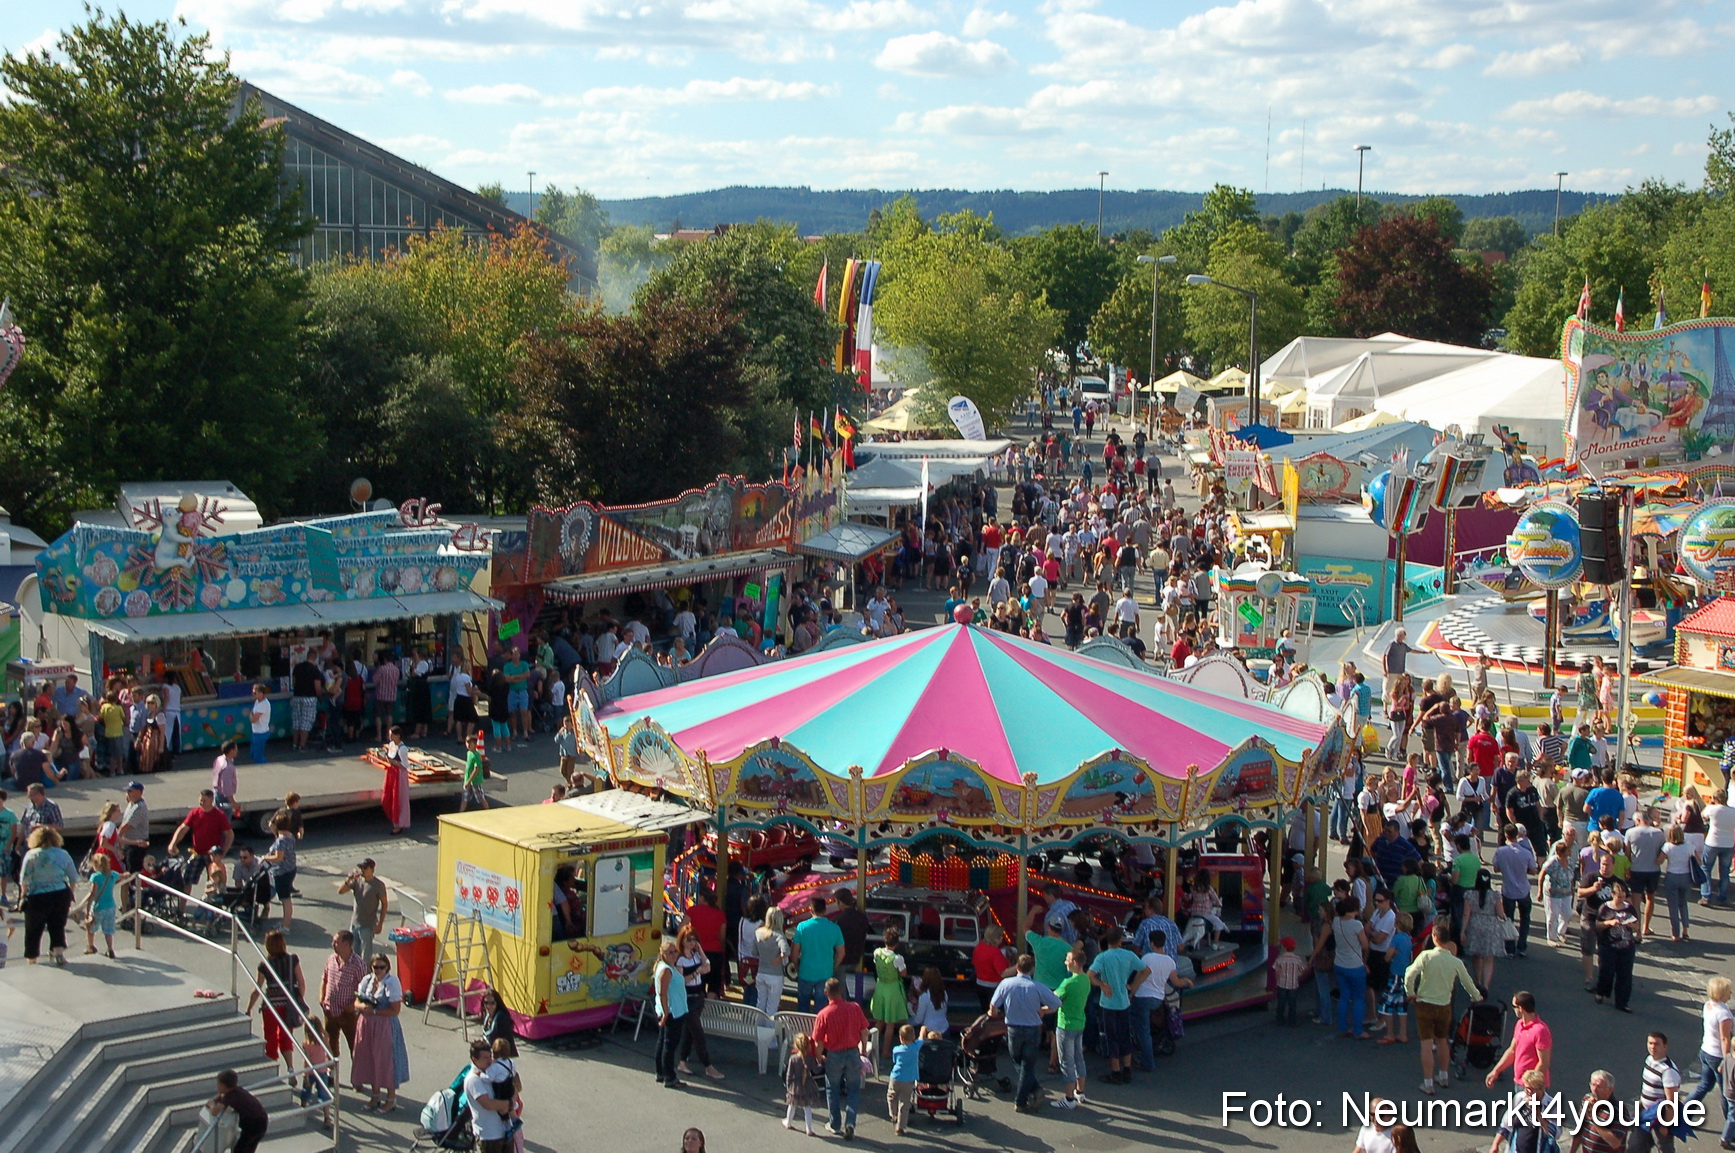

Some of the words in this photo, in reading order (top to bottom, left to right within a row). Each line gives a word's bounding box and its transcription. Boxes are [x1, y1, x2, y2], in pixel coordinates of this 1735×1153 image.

[1580, 435, 1666, 461] Montmartre
[756, 499, 794, 544] EXPRESS
[27, 665, 74, 676] POPCORN
